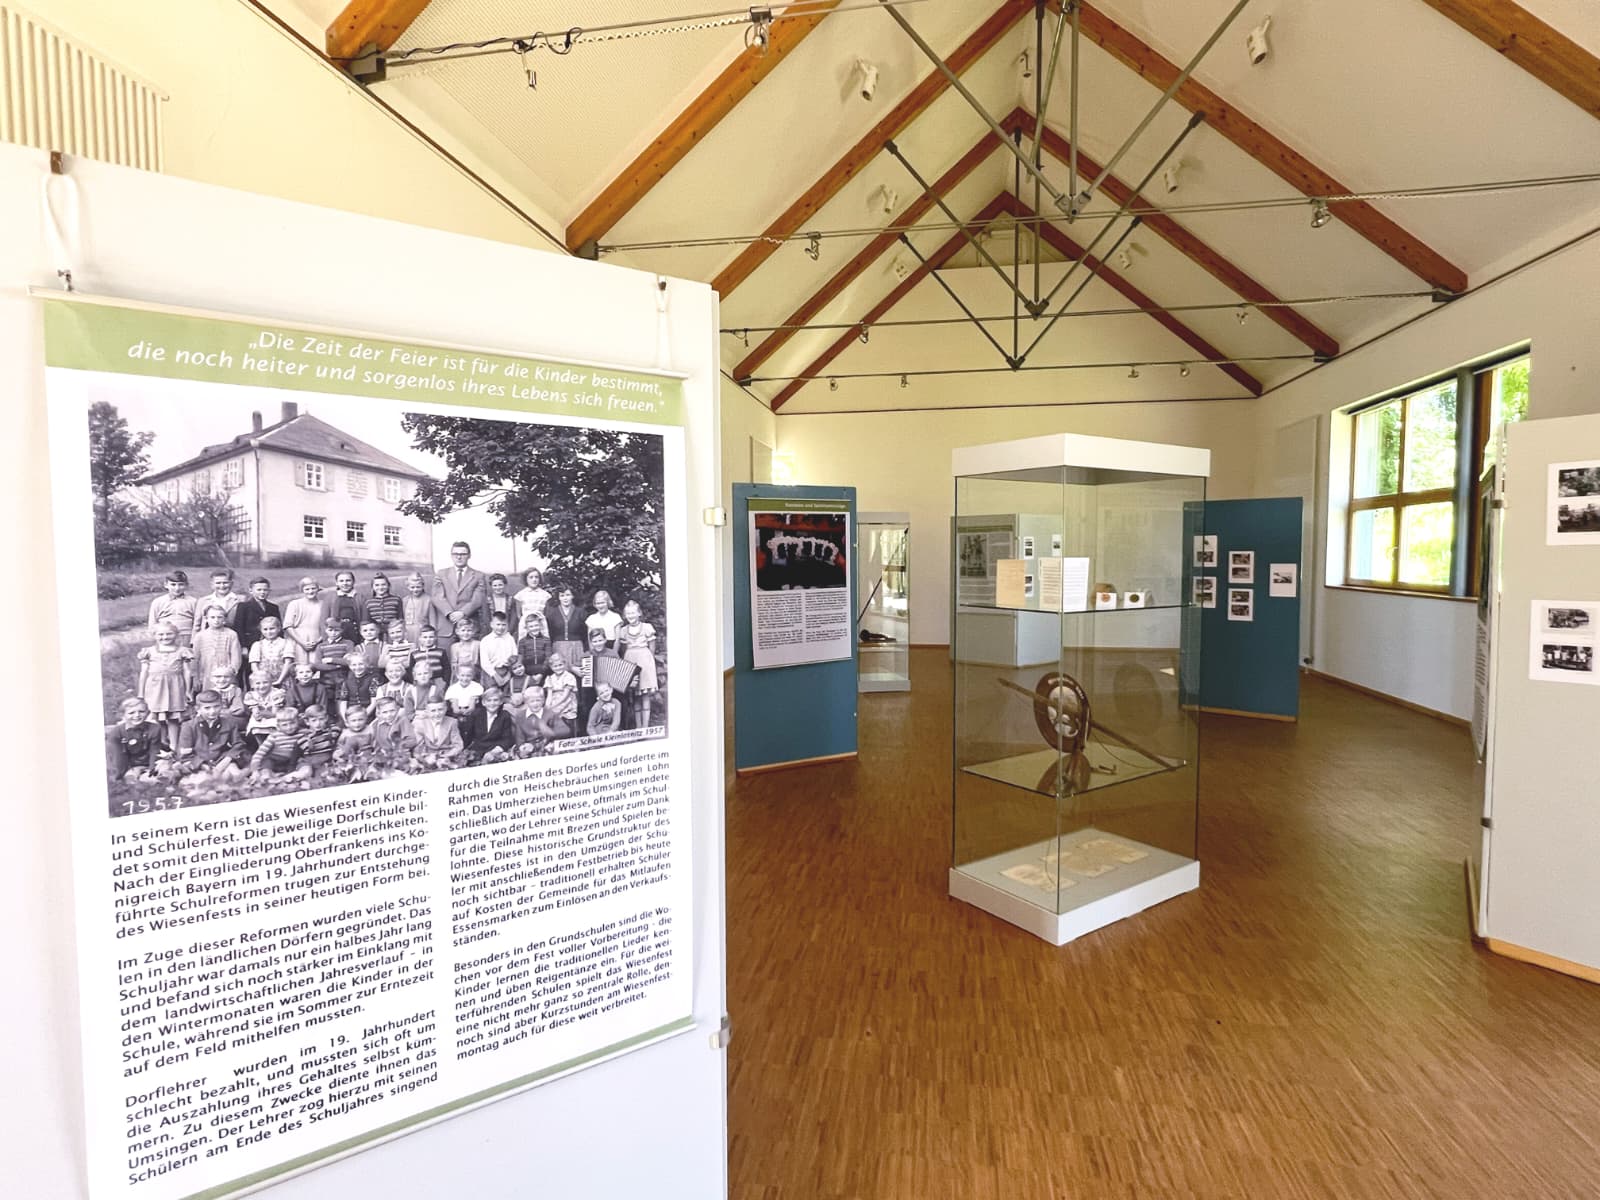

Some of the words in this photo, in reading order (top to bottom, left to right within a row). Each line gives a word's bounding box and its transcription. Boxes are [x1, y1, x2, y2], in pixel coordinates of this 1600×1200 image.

[128, 340, 165, 361] die
[175, 350, 233, 369] noch
[242, 354, 309, 375] heiter
[316, 366, 356, 381] und
[363, 371, 456, 392] sorgenlos
[462, 378, 505, 397] ihres
[512, 384, 568, 403] Lebens
[574, 393, 603, 406] sich
[301, 337, 343, 357] Zeit
[349, 343, 384, 361] der
[390, 348, 438, 367] Feier
[443, 358, 467, 371] ist
[471, 358, 499, 375] für
[504, 363, 529, 378] die
[535, 367, 587, 385] Kinder
[592, 373, 662, 397] bestimmt,
[579, 737, 603, 746] Schule
[645, 727, 664, 736] 1957
[111, 834, 126, 846] In
[132, 826, 189, 842] seinem
[194, 820, 229, 833] Kern
[234, 816, 251, 827] ist
[255, 812, 280, 823] das
[283, 799, 356, 819] Wiesenfest
[360, 796, 380, 806] ein
[383, 789, 427, 803] Kinder-
[112, 845, 143, 861] und
[148, 833, 240, 855] Schülerfest.
[244, 829, 268, 840] Die
[272, 818, 333, 838] jeweilige
[336, 805, 406, 824] Dorfschule
[409, 801, 427, 812] bil-
[113, 863, 139, 877] det
[143, 856, 187, 871] somit
[190, 852, 219, 863] den
[222, 836, 305, 859] Mittelpunkt
[307, 832, 329, 844] der
[332, 816, 428, 839] Feierlichkeiten.
[114, 875, 154, 893] Nach
[159, 871, 185, 884] der
[189, 854, 291, 879] Eingliederung
[295, 837, 385, 860] Oberfrankens
[388, 833, 406, 843] ins
[115, 886, 180, 908] nigreich
[186, 878, 237, 895] Bayern
[242, 874, 260, 885] im
[266, 868, 287, 880] 19.
[290, 852, 371, 877] Jahrhundert
[375, 843, 429, 859] durchge-
[115, 906, 165, 924] führte
[170, 885, 280, 913] Schulreformen
[285, 875, 330, 891] trugen
[335, 869, 355, 881] zur
[360, 855, 430, 876] Entstehung
[116, 925, 145, 939] des
[149, 907, 241, 931] Wiesenfests
[246, 903, 259, 913] in
[264, 893, 306, 910] seiner
[311, 881, 369, 899] heutigen
[372, 873, 404, 887] Form
[408, 869, 430, 879] bei.
[118, 958, 138, 971] Im
[144, 948, 183, 964] Zuge
[189, 938, 235, 954] dieser
[240, 922, 309, 944] Reformen
[312, 909, 362, 927] wurden
[366, 901, 395, 915] viele
[398, 895, 432, 908] Schu-
[119, 972, 143, 986] len
[148, 968, 163, 978] in
[167, 961, 196, 974] den
[200, 943, 277, 967] ländlichen
[281, 930, 333, 949] Dörfern
[336, 913, 406, 938] gegründet.
[409, 907, 432, 919] Das
[119, 975, 194, 1002] Schuljahr
[197, 969, 225, 982] war
[228, 956, 281, 976] damals
[284, 950, 307, 963] nur
[310, 944, 331, 956] ein
[334, 933, 376, 950] halbes
[378, 927, 403, 941] Jahr
[406, 920, 432, 933] lang
[121, 998, 152, 1017] und
[156, 985, 210, 1007] befand
[214, 978, 244, 994] sich
[248, 969, 283, 986] noch
[286, 957, 334, 976] stärker
[337, 952, 353, 963] im
[357, 939, 410, 958] Einklang
[413, 932, 432, 944] mit
[121, 1015, 156, 1032] dem
[165, 977, 314, 1020] landwirtschaftlichen
[320, 950, 404, 983] Jahresverlauf
[422, 946, 433, 955] in
[122, 1032, 152, 1047] den
[158, 1001, 274, 1037] Wintermonaten
[279, 989, 321, 1006] waren
[326, 982, 347, 993] die
[352, 969, 393, 987] Kinder
[398, 965, 409, 975] in
[414, 959, 433, 970] der
[123, 1040, 180, 1063] Schule,
[184, 1019, 249, 1045] während
[253, 1016, 273, 1028] sie
[277, 1010, 294, 1022] im
[298, 994, 353, 1016] Sommer
[356, 987, 377, 999] zur
[380, 971, 434, 993] Erntezeit
[124, 1060, 149, 1078] auf
[155, 1052, 189, 1068] dem
[195, 1040, 227, 1057] Feld
[232, 1023, 300, 1048] mithelfen
[305, 1005, 365, 1028] mussten.
[126, 1077, 207, 1108] Dorflehrer
[233, 1055, 287, 1077] wurden
[300, 1046, 317, 1057] im
[330, 1035, 350, 1048] 19.
[362, 1009, 435, 1040] Jahrhundert
[126, 1095, 192, 1123] schlecht
[200, 1077, 260, 1101] bezahlt,
[267, 1064, 294, 1081] und
[301, 1047, 358, 1071] mussten
[363, 1036, 389, 1051] sich
[394, 1029, 411, 1042] oft
[417, 1023, 436, 1035] um
[127, 1124, 152, 1138] die
[159, 1094, 250, 1128] Auszahlung
[258, 1081, 292, 1098] ihres
[299, 1061, 357, 1085] Gehaltes
[363, 1046, 400, 1065] selbst
[128, 1133, 174, 1154] mern.
[183, 1123, 202, 1136] Zu
[210, 1105, 263, 1127] diesem
[271, 1086, 322, 1109] Zwecke
[328, 1070, 370, 1090] diente
[376, 1057, 410, 1074] ihnen
[416, 1048, 437, 1061] das
